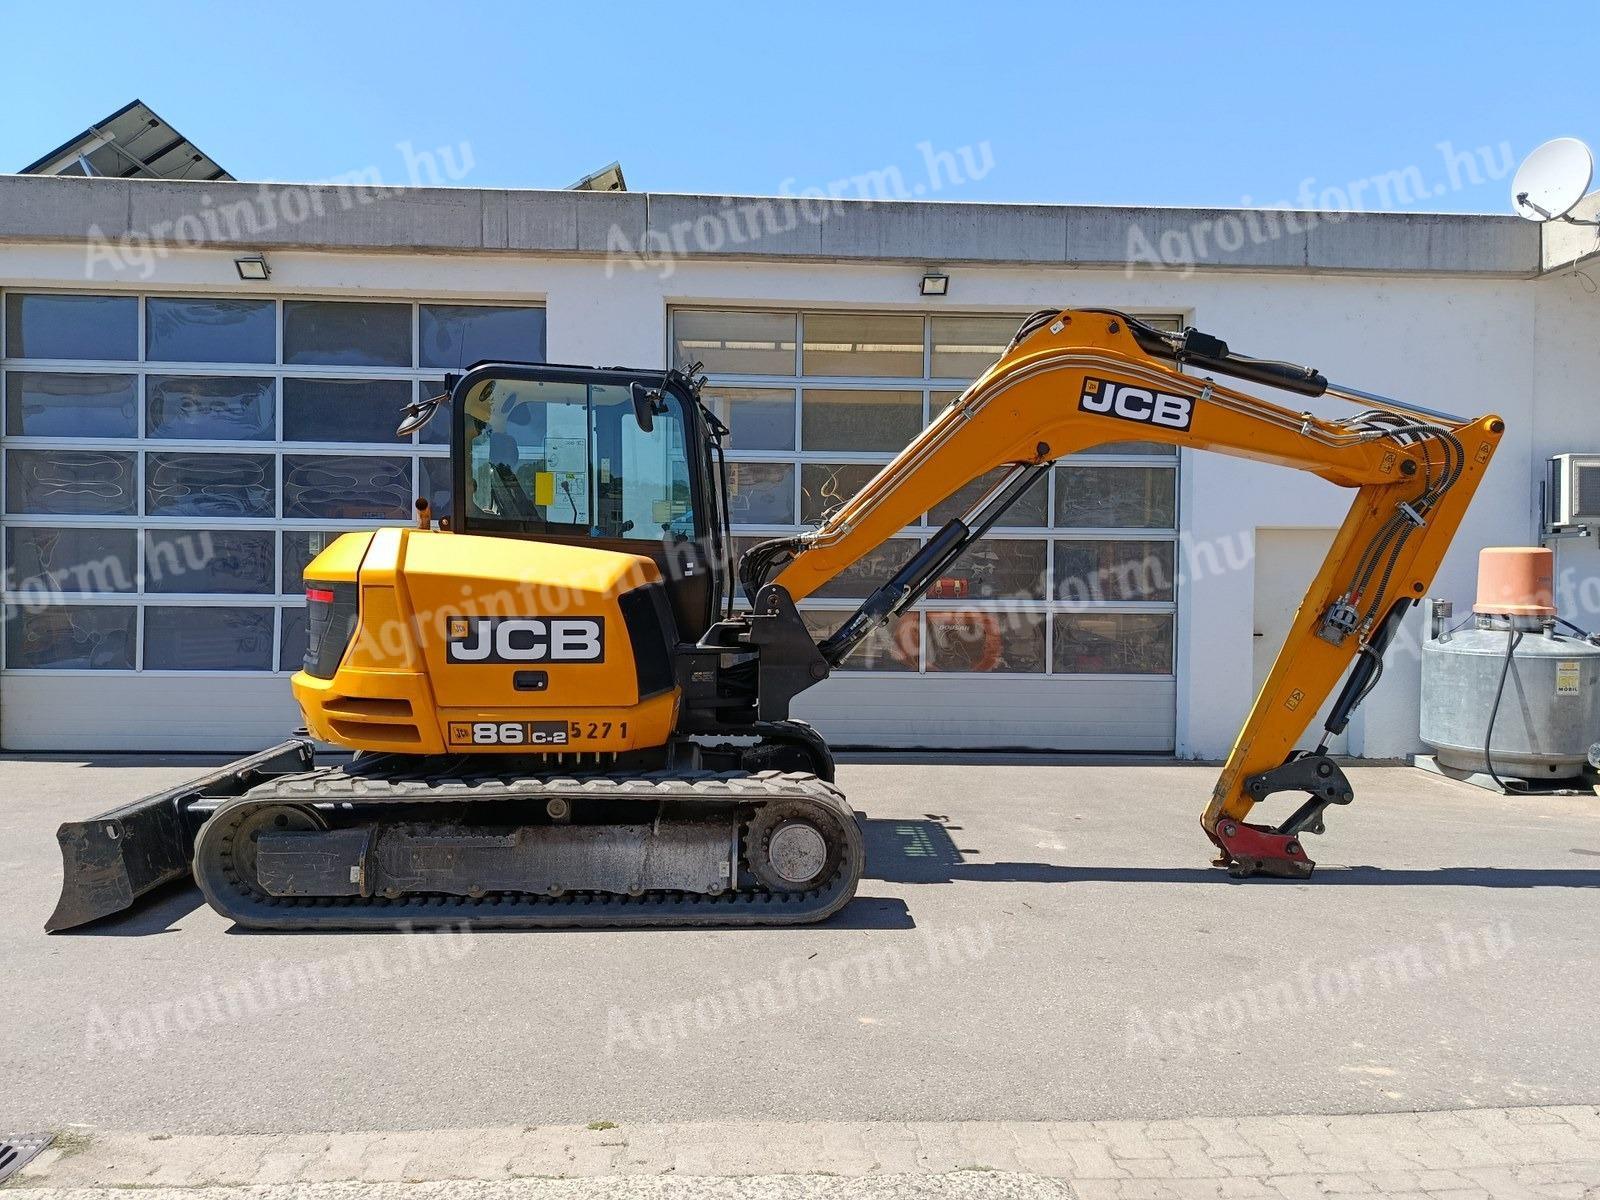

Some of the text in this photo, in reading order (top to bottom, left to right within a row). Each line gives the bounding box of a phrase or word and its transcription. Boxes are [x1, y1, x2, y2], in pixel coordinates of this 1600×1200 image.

[1083, 383, 1191, 428] JCB
[451, 620, 601, 660] JCB
[473, 723, 524, 744] 86
[532, 732, 567, 743] C-2
